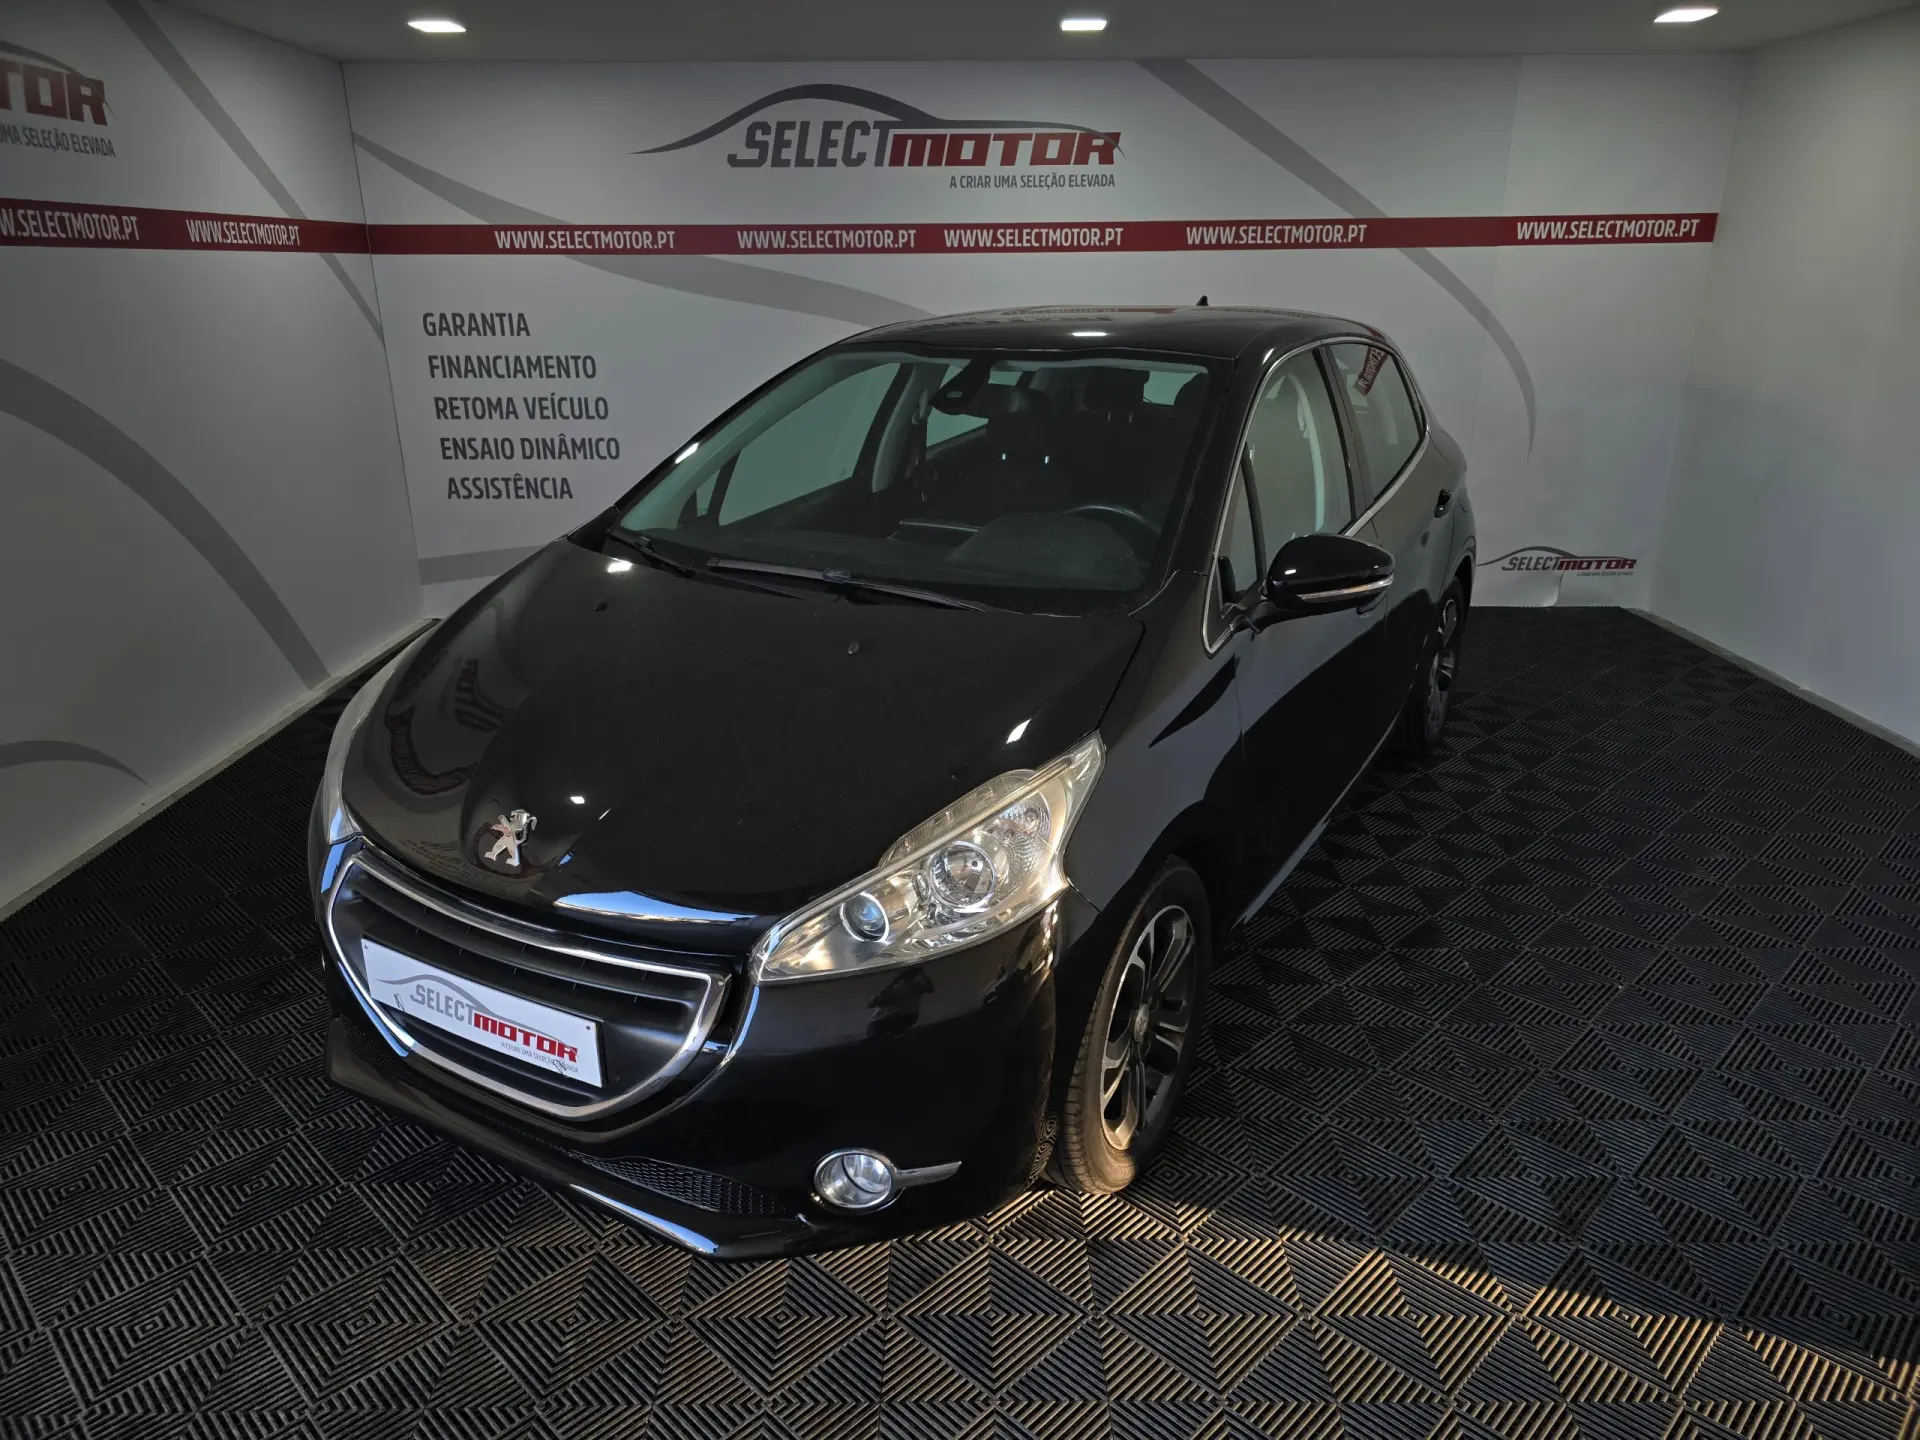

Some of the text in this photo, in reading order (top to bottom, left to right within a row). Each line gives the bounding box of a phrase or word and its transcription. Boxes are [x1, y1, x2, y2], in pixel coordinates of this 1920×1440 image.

[21, 127, 70, 154] SELEÇÃO
[69, 133, 117, 158] ELEVADA
[726, 120, 1122, 168] SELECTMOTOR
[949, 172, 1116, 190] A CRIAR UMA SELEÇÃO ELEVADA
[185, 218, 301, 246] WWW.SELECTMOTOR.PT
[494, 230, 676, 250] WWW.SELECTMOTOR.PT
[736, 229, 917, 249] WWW.SELECTMOTOR.PT
[943, 227, 1124, 248] WWW.SELECTMOTOR.PT
[1186, 224, 1368, 245] WWW.SELECTMOTOR.PT
[1516, 219, 1700, 240] WWW.SELECTMOTOR.PT
[422, 312, 531, 337] GARANTIA
[427, 354, 597, 379] FINANCIAMENTO
[434, 391, 609, 420] RETOMA VEÍCULO
[439, 432, 620, 460] ENSAIO DINÂMICO
[447, 473, 574, 500] ASSISTÊNCIA
[1501, 556, 1638, 571] SELECTMOTOR
[409, 983, 578, 1064] SELECTMOTOR
